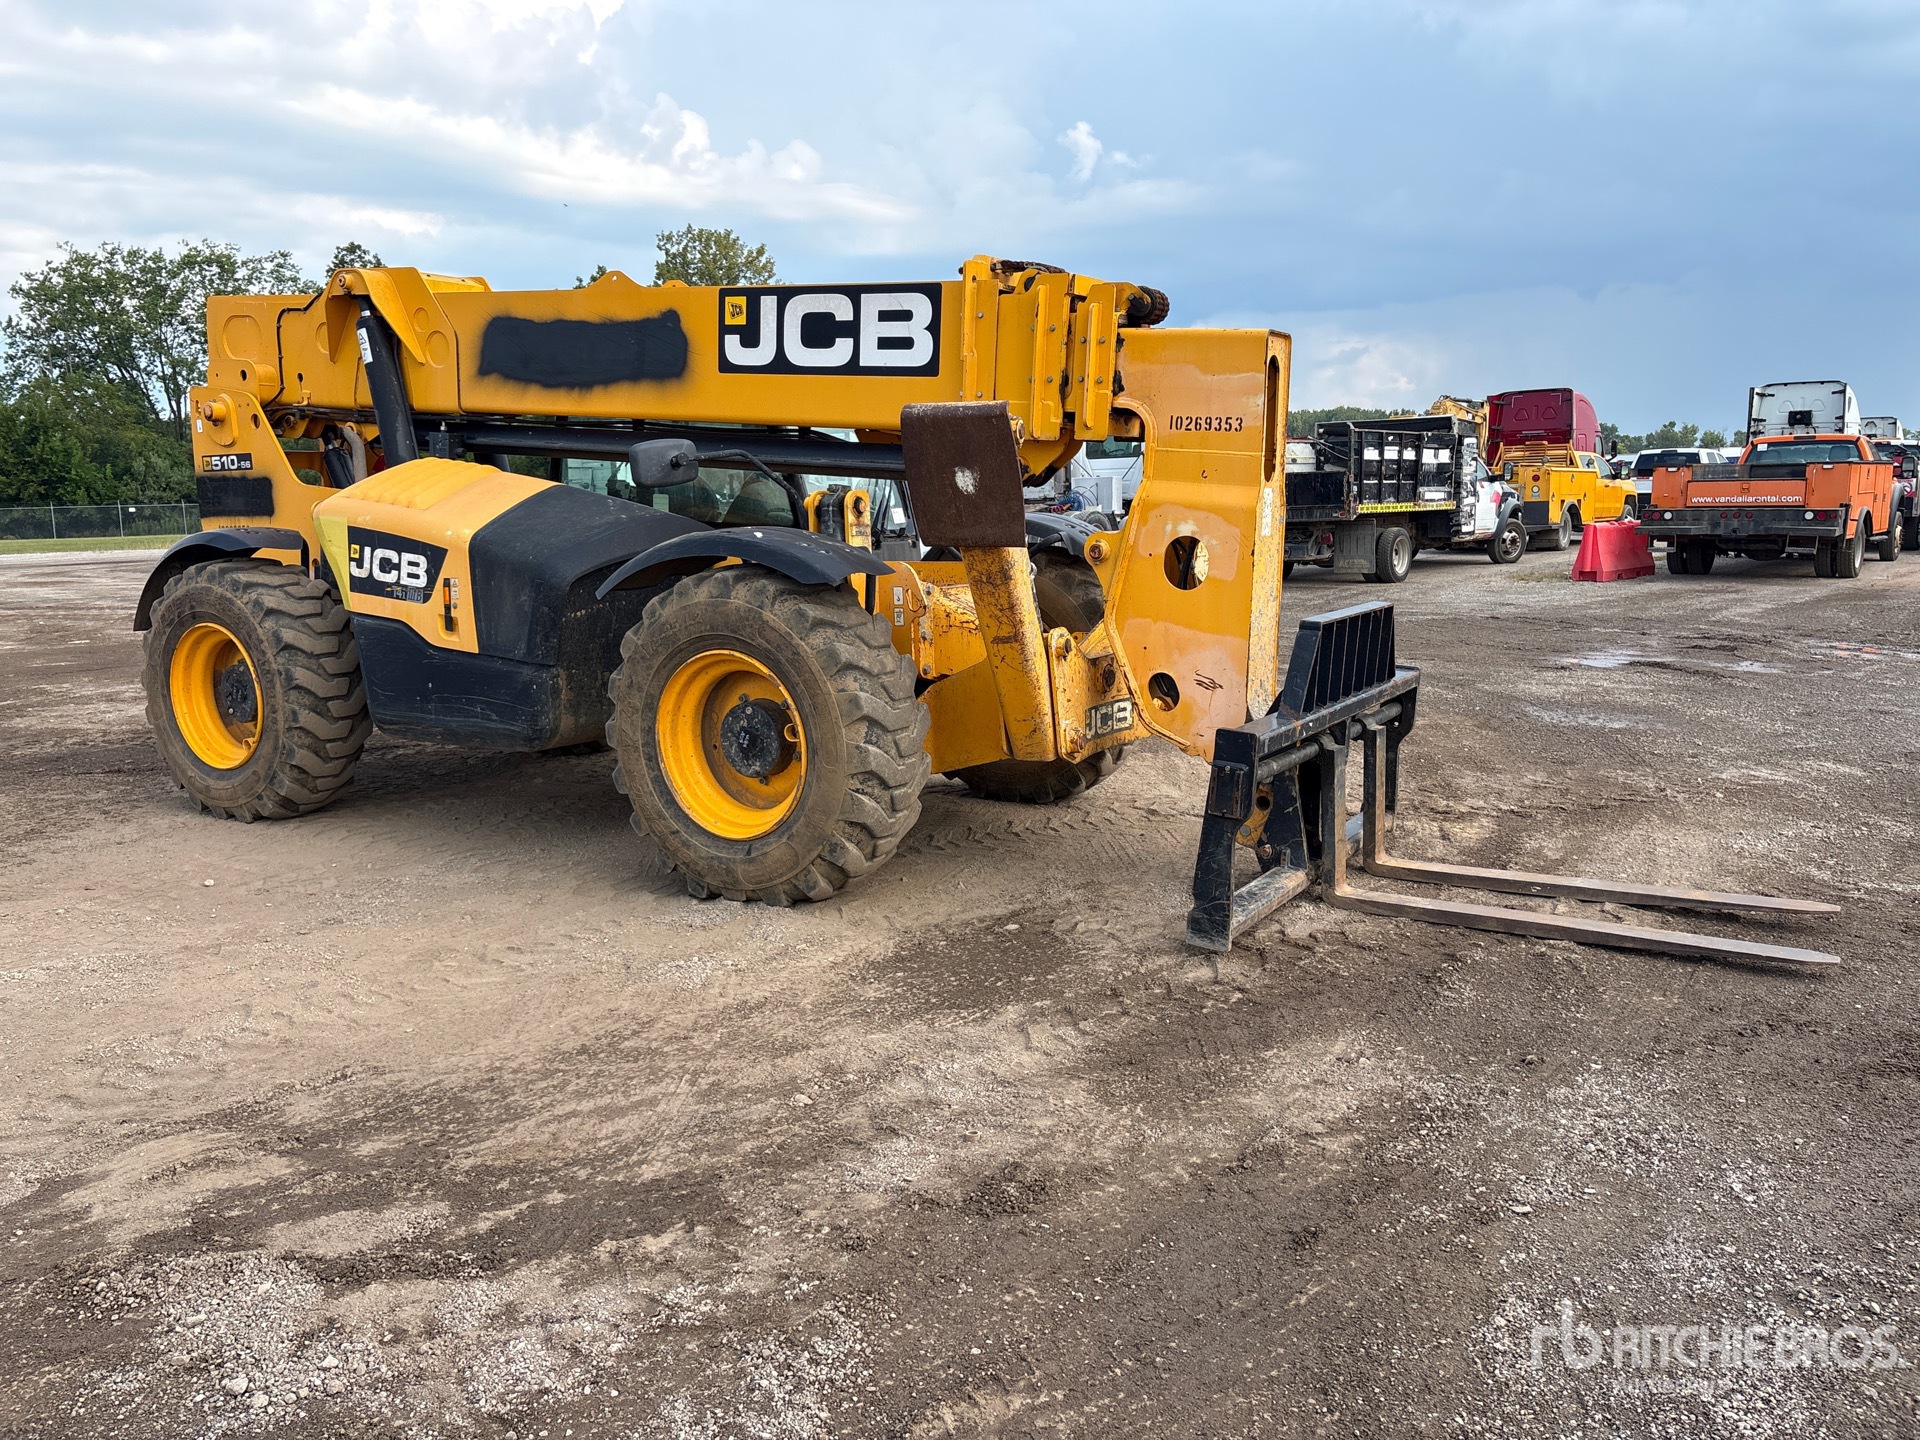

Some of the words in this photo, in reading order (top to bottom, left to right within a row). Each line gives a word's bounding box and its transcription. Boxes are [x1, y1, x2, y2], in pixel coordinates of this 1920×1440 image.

[725, 292, 934, 367] JCB
[1169, 415, 1243, 433] 10269353
[211, 455, 251, 471] 510-56
[349, 546, 428, 588] JCB
[1085, 700, 1133, 740] JCB
